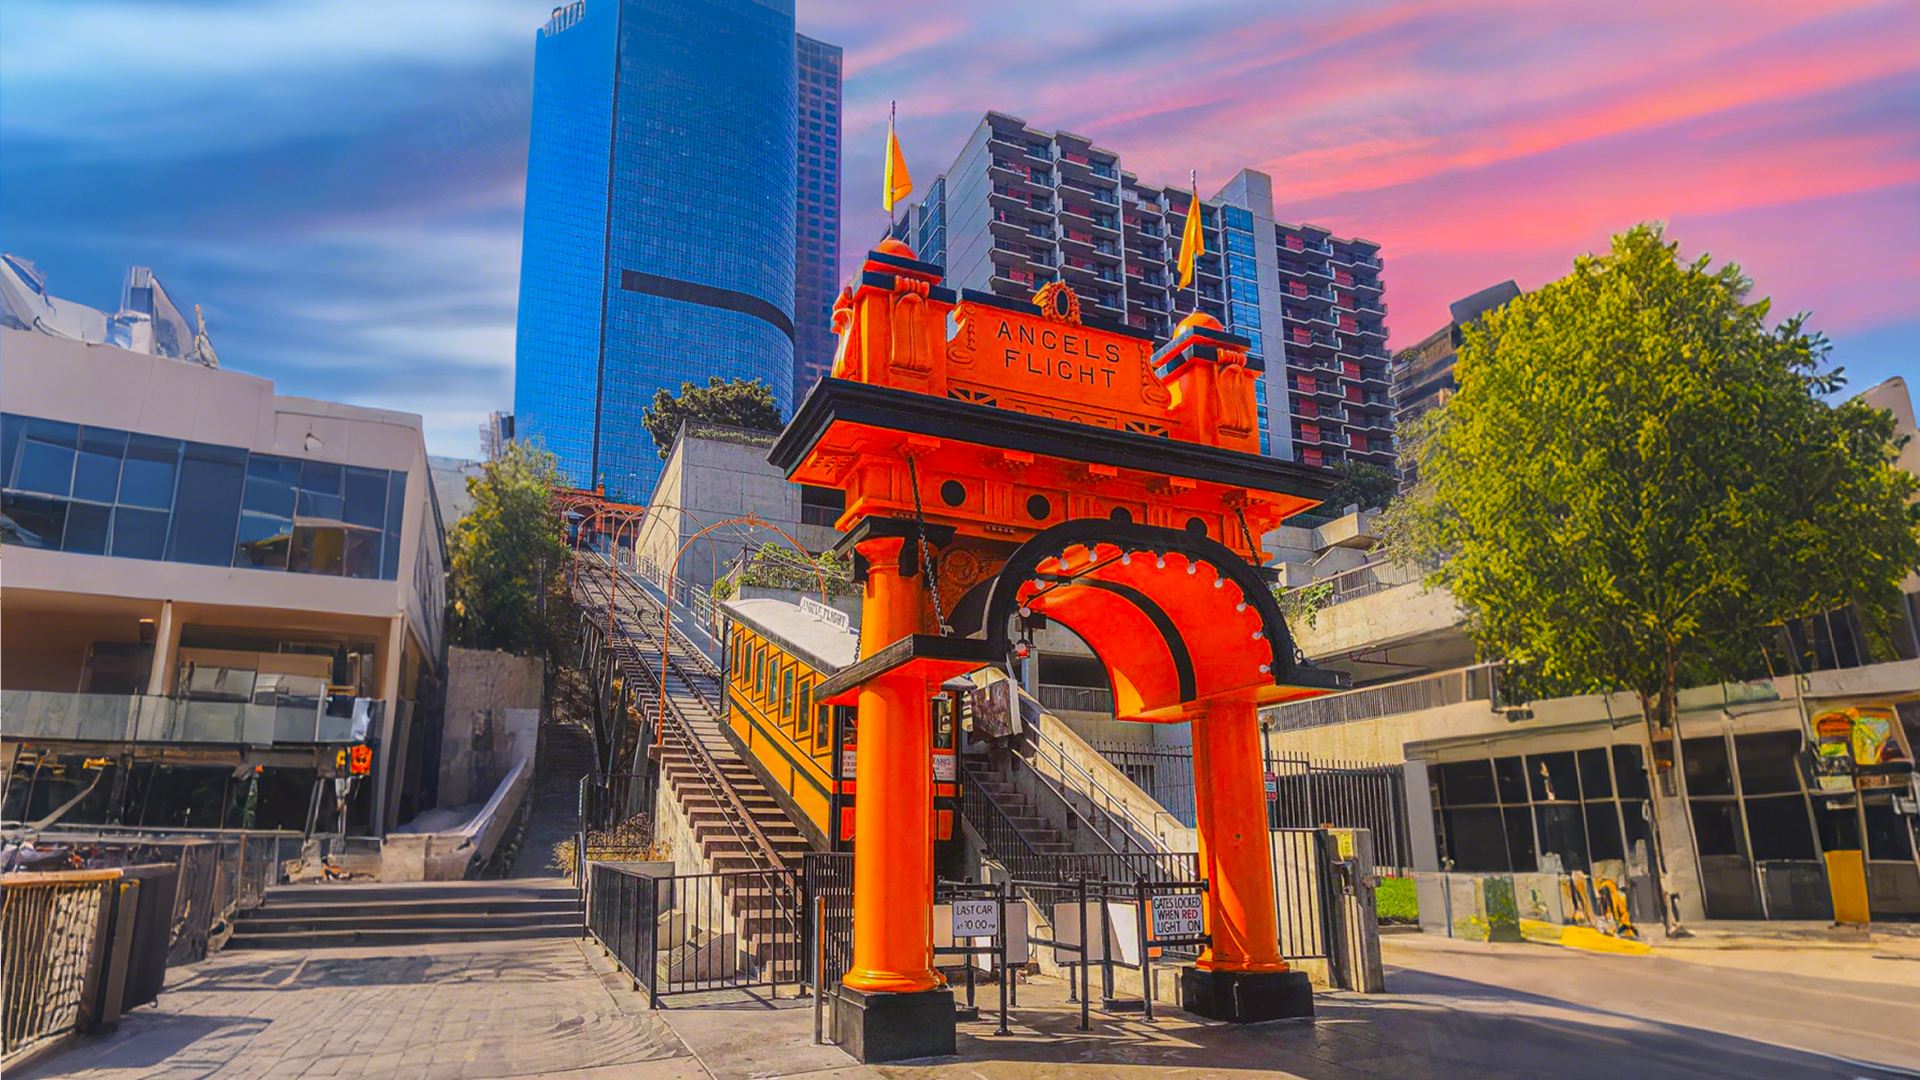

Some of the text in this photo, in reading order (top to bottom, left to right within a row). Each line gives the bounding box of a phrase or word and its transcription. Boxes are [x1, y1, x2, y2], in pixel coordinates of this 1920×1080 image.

[956, 904, 993, 915] LAST CAR
[1153, 896, 1202, 910] GATES LOCKED
[1157, 908, 1199, 921] WHEN RED
[1157, 920, 1201, 933] LIGHT ON
